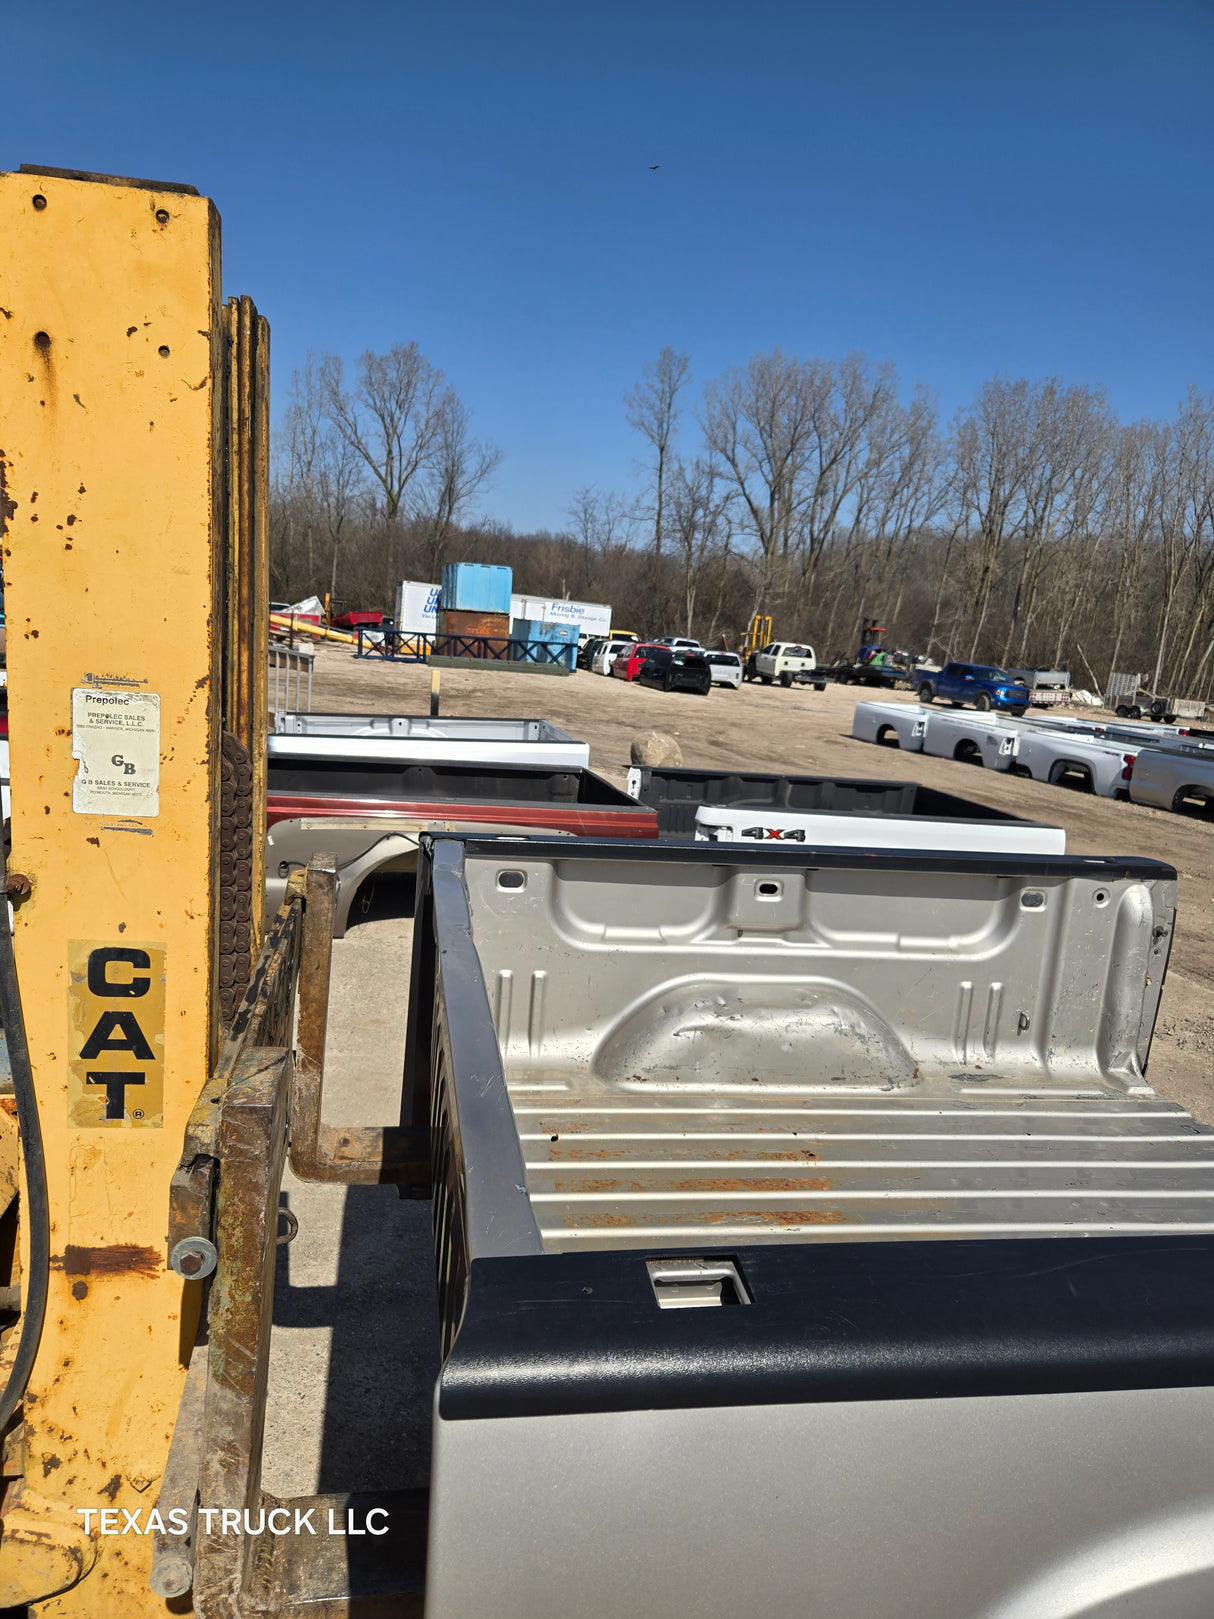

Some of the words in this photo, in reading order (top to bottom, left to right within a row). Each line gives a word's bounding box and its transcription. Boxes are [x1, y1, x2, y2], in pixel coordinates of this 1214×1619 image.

[551, 602, 585, 615] Frisbie
[549, 611, 569, 619] Moving
[85, 694, 130, 706] Prepolec
[87, 712, 123, 720] PREPOLEC
[79, 947, 156, 1120] CAT
